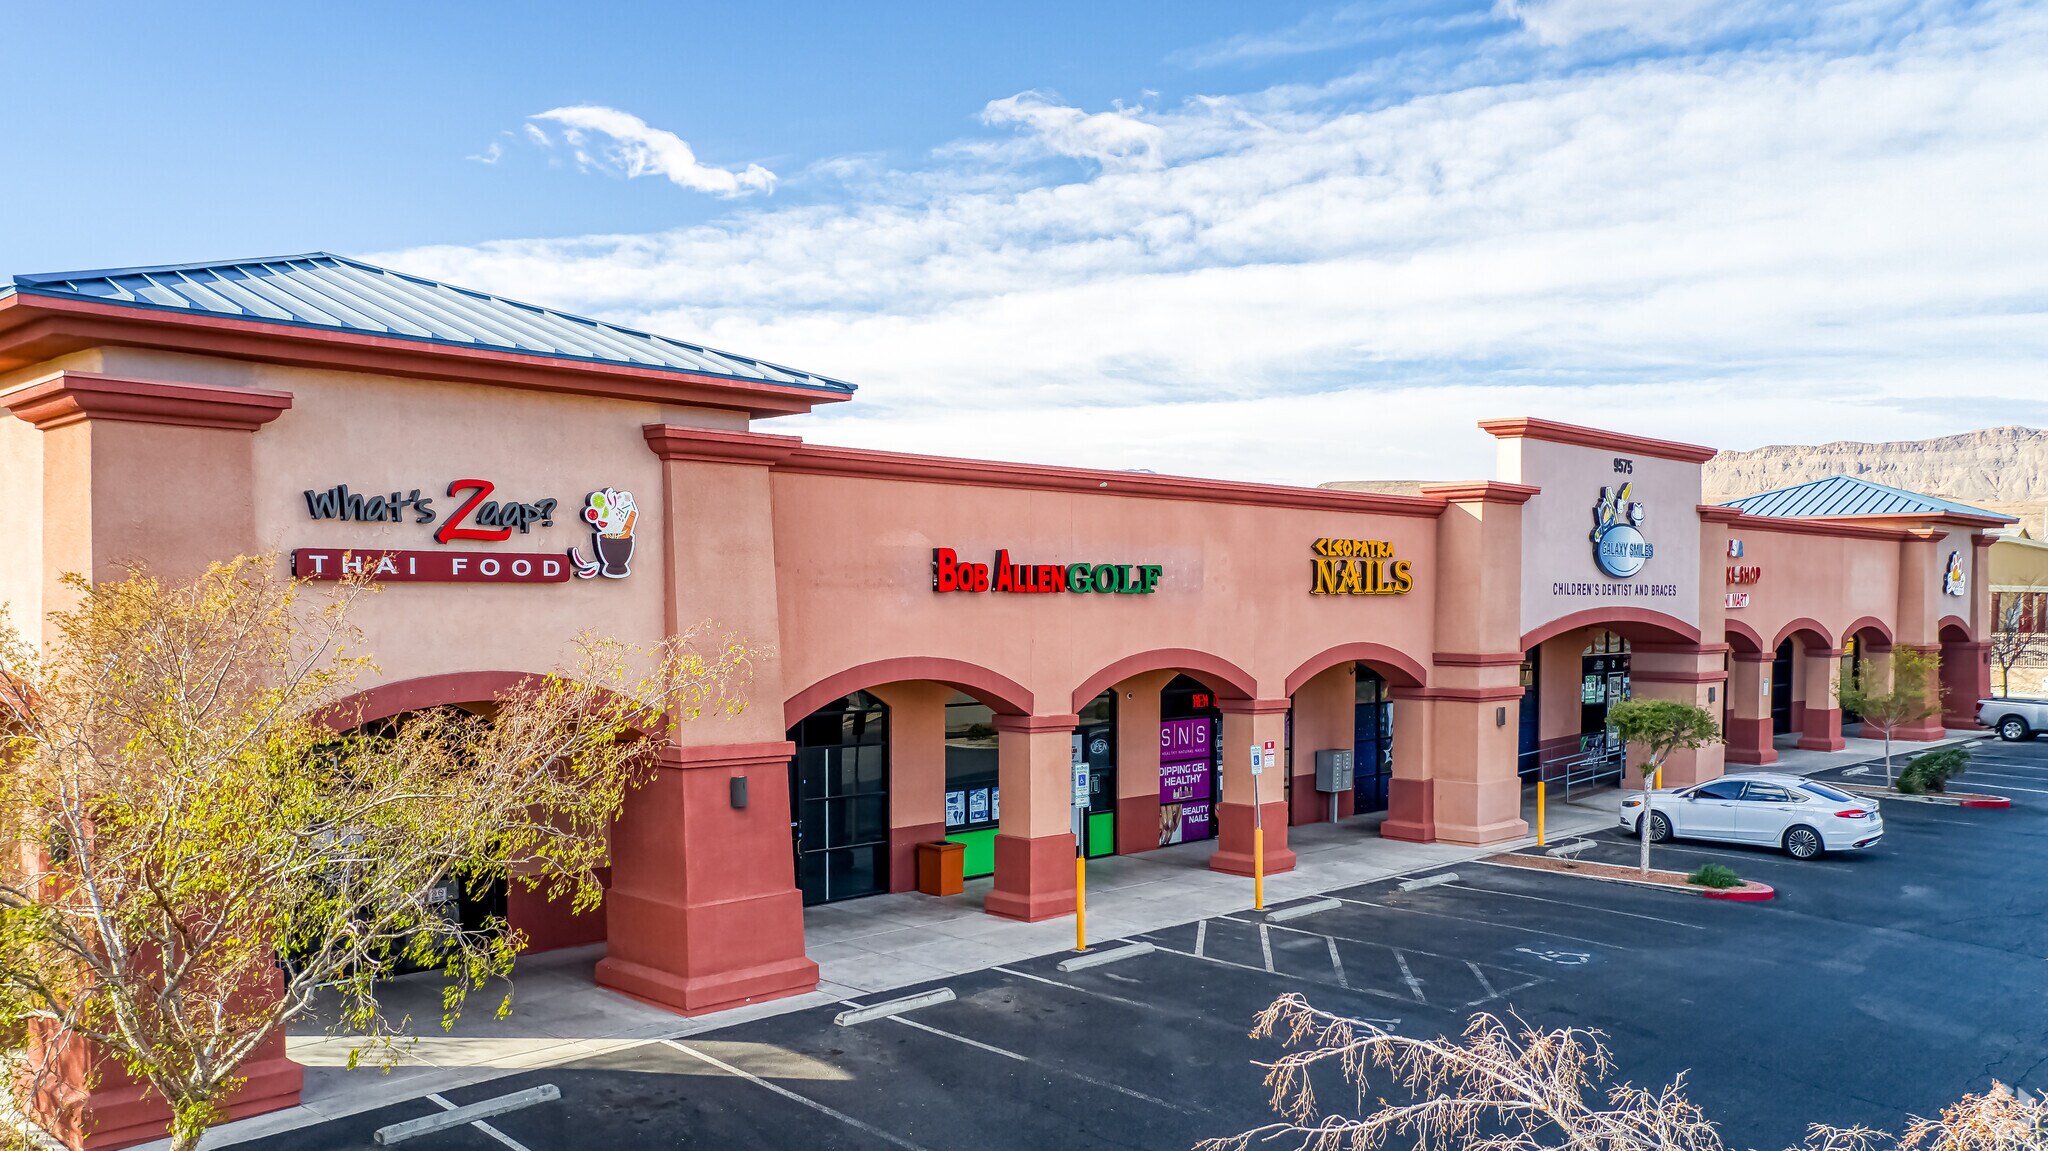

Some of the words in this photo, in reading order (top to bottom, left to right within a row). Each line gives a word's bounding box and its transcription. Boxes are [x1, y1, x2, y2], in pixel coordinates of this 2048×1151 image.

[1613, 458, 1633, 474] 9575
[304, 484, 436, 524] What's
[434, 479, 558, 544] Zaap?
[1312, 538, 1395, 558] CLEOPATRA
[1602, 542, 1627, 556] GALAXY
[1629, 544, 1654, 558] SMILES
[308, 555, 416, 576] THAI
[452, 558, 561, 577] FOOD
[934, 548, 989, 592] BOB
[992, 549, 1065, 593] ALLEN
[1066, 563, 1163, 594] GOLF
[1311, 558, 1413, 595] NAILS
[1739, 566, 1761, 584] SHOP
[1552, 582, 1600, 596] CHILDREN'S
[1602, 583, 1632, 596] DENTIST
[1635, 584, 1649, 596] AND
[1651, 584, 1677, 597] BRACES
[1160, 765, 1191, 777] DIPPING
[1192, 763, 1207, 772] GEL
[1164, 774, 1202, 787] HEALTHY
[1182, 805, 1209, 816] BEAUTY
[1189, 814, 1209, 824] NAILS
